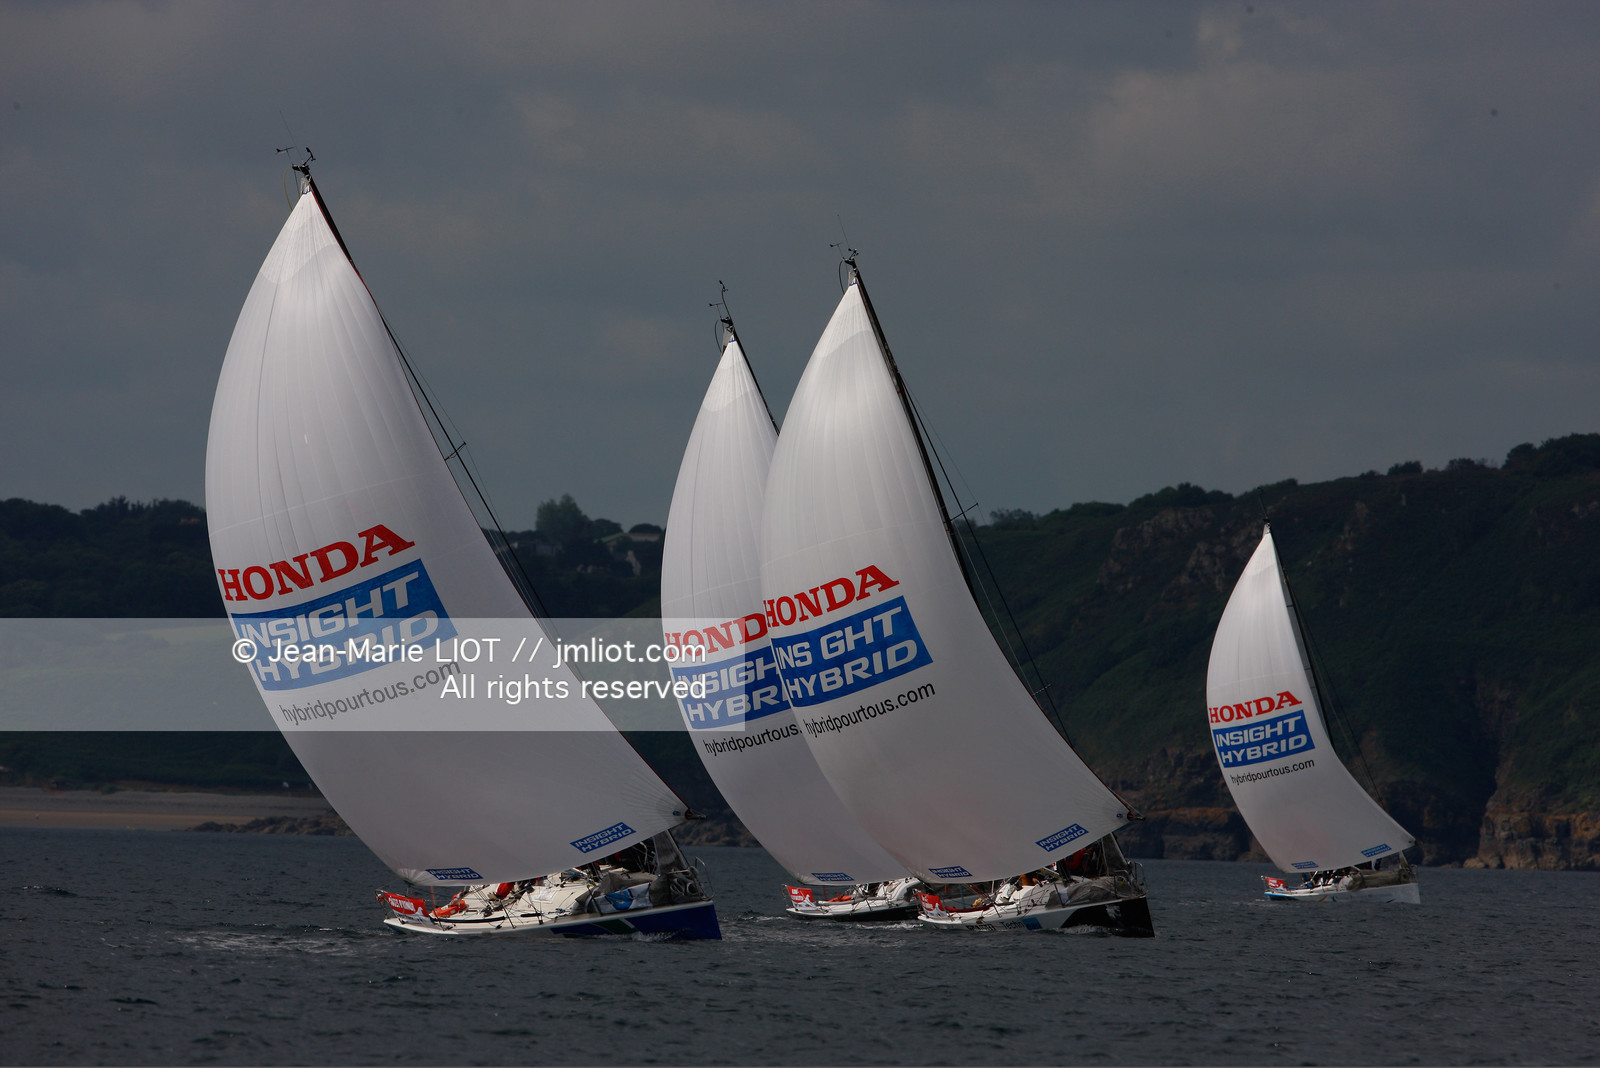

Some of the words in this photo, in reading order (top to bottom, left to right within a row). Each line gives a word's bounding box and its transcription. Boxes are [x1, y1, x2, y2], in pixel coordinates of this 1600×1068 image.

[218, 524, 415, 601] HONDA
[240, 571, 419, 648] INSIGHT
[763, 564, 900, 628] HONDA
[256, 609, 439, 682] HYBRID
[664, 612, 768, 658] HOND
[677, 656, 779, 695] INSIGH
[786, 639, 918, 700] HYBRID
[280, 662, 462, 726] hybridpourtous.com
[686, 685, 790, 722] HYBR
[803, 682, 936, 738] hybridpourtous.com
[1209, 690, 1302, 724] HONDA
[703, 723, 803, 756] hybridpourtous.
[1216, 715, 1302, 748] INSIGHT
[1221, 735, 1308, 764] HYBRID
[1230, 759, 1315, 786] hybridpourtous.com
[575, 823, 624, 848] INSIGHT
[582, 828, 632, 852] HYBRID
[1039, 824, 1078, 847] INSIGHT
[1045, 829, 1086, 850] HYBRID
